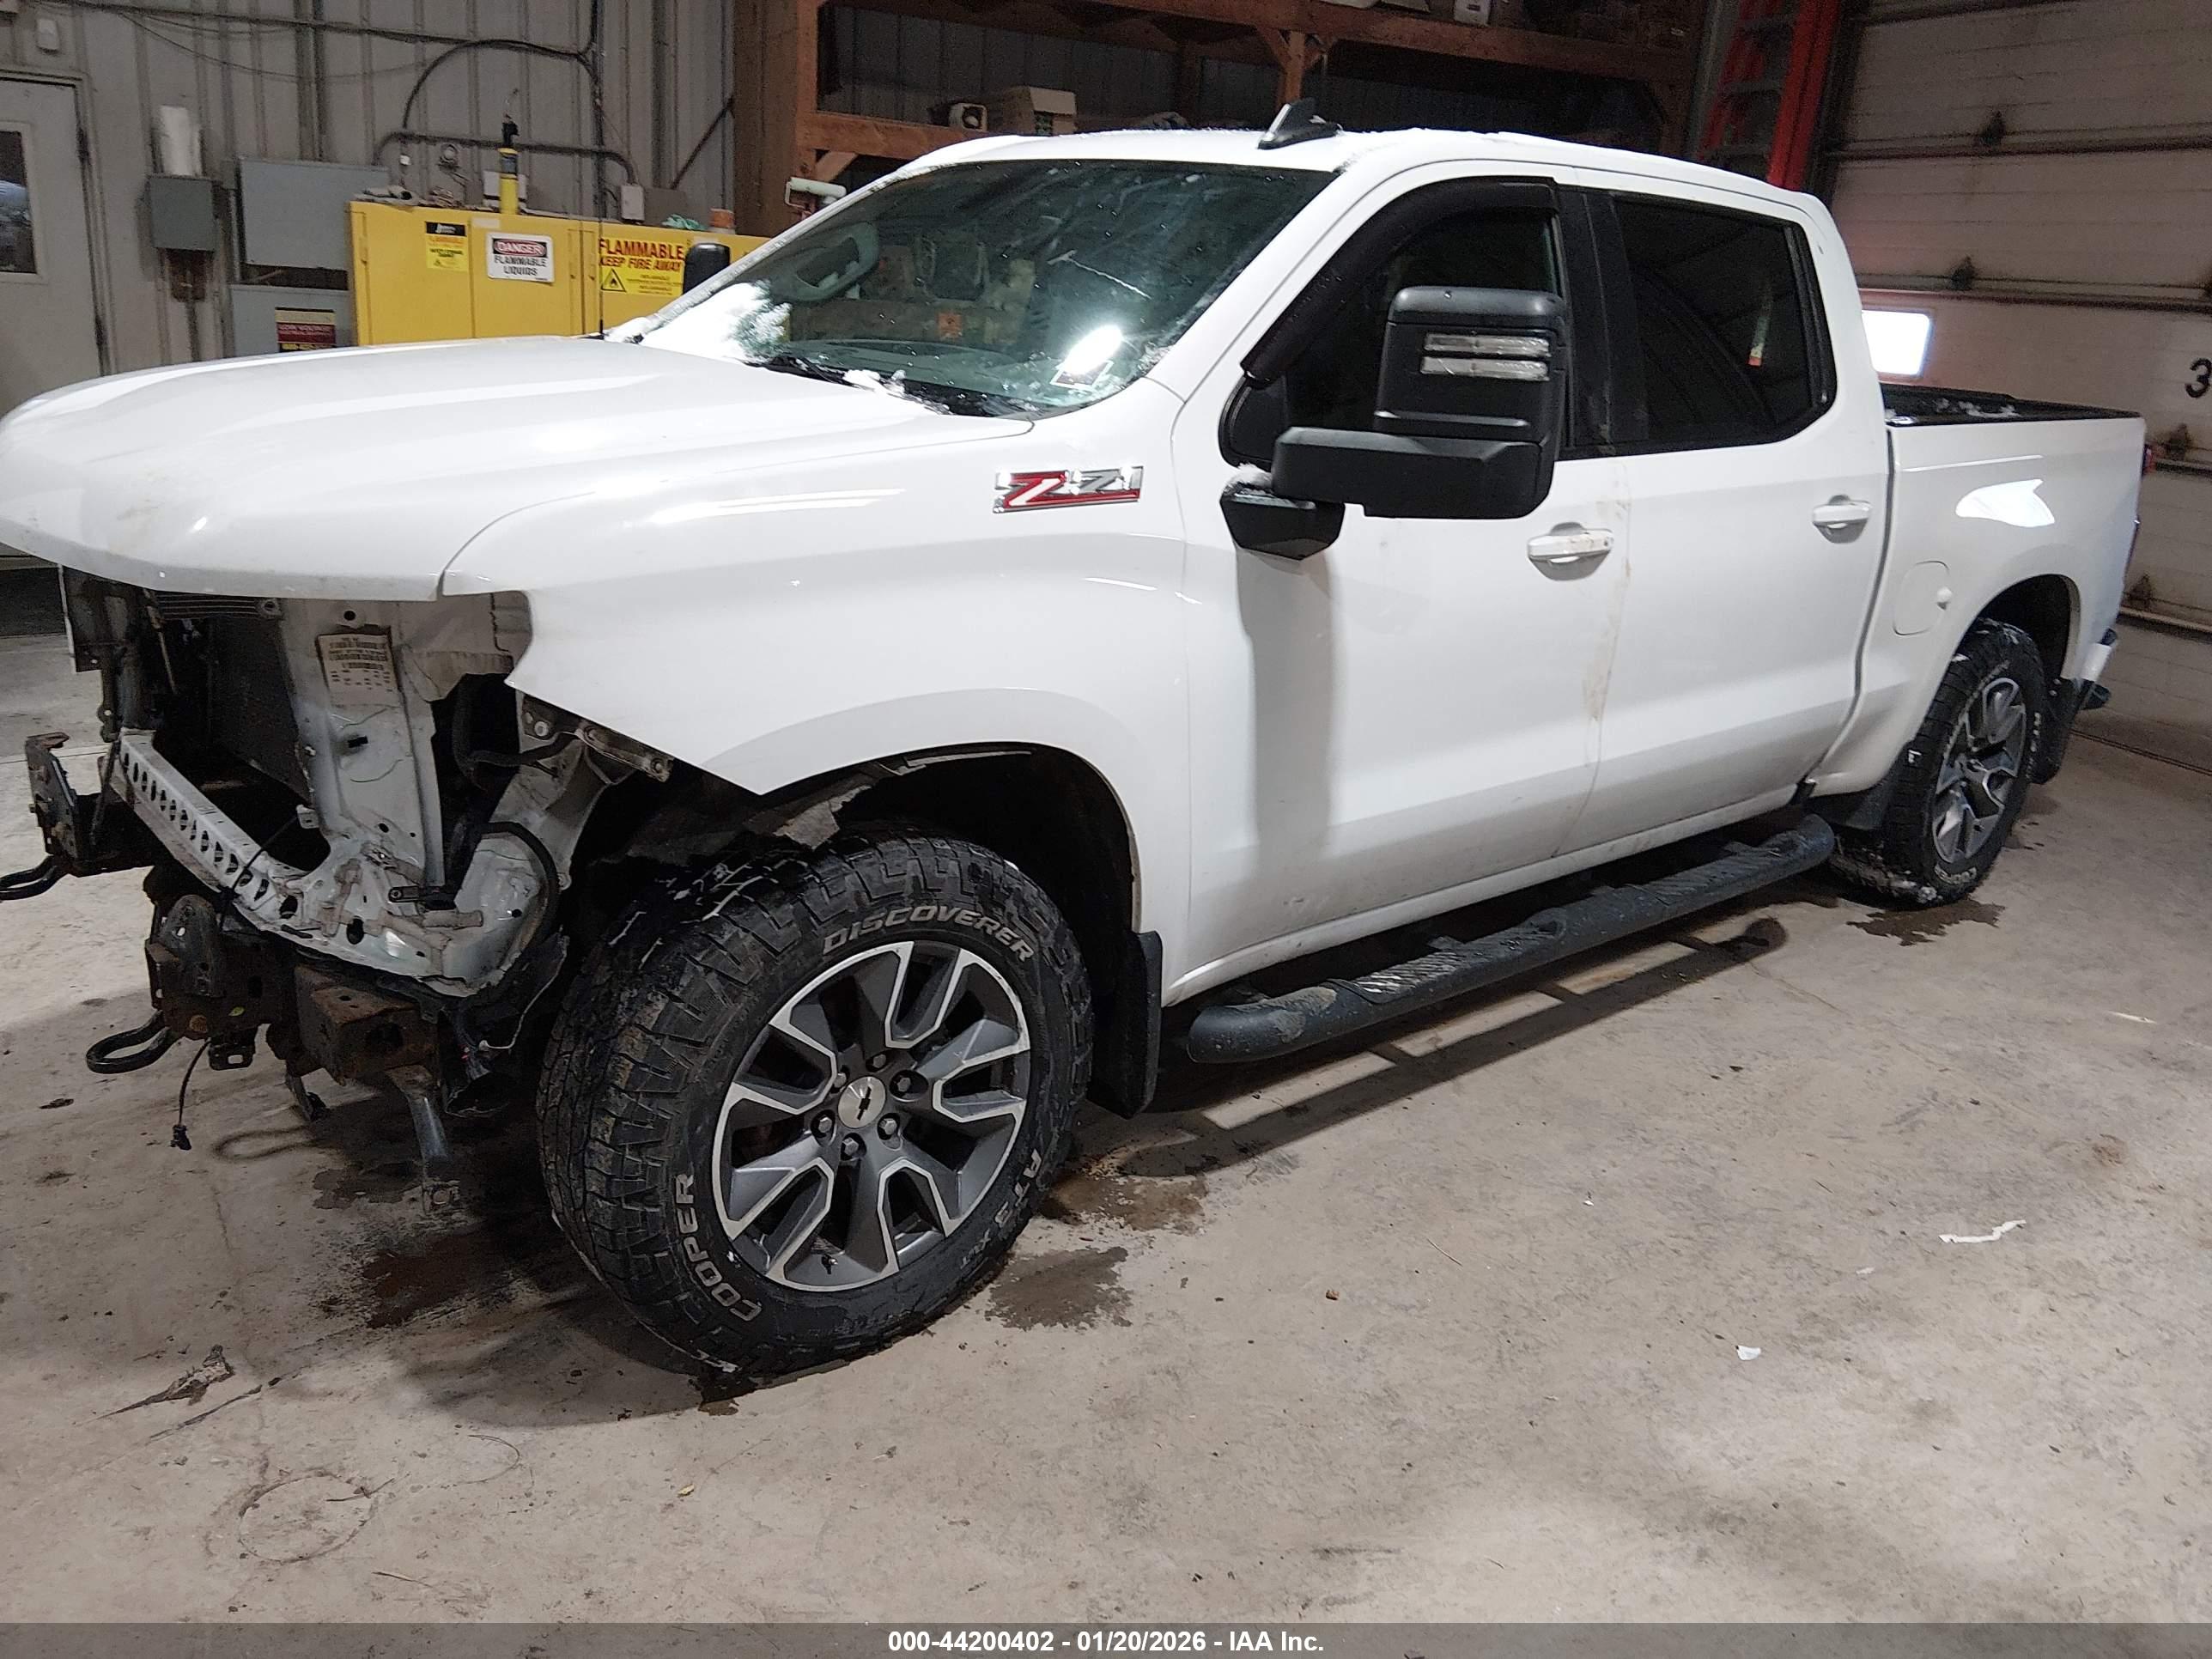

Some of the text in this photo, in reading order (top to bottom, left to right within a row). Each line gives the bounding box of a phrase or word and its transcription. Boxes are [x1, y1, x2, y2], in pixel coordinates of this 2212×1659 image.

[496, 241, 544, 254] DANGER
[599, 238, 684, 260] FLAMMABLE
[494, 255, 547, 267] FLAMMABLE
[628, 258, 652, 270] FIRE
[653, 259, 681, 272] AWAY
[503, 266, 538, 276] LIQUIDS
[993, 465, 1144, 514] Z71
[823, 905, 1035, 963] DISCOVERER
[675, 1173, 763, 1322] COOPER
